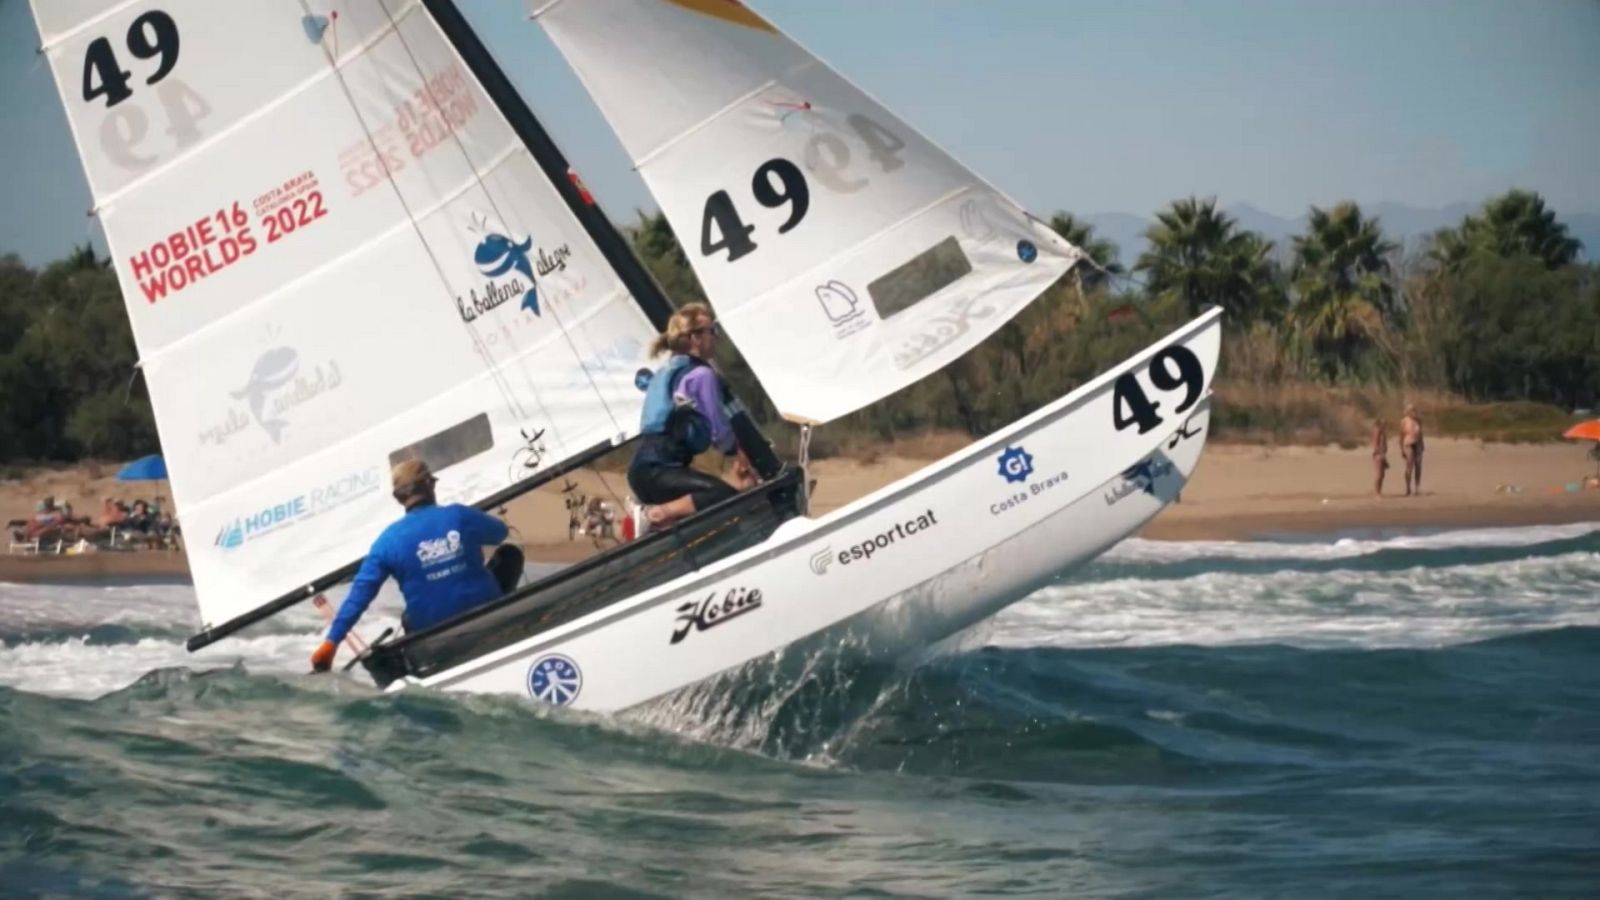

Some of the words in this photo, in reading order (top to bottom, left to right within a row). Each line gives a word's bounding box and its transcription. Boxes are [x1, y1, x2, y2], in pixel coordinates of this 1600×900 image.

[82, 10, 180, 108] 49
[130, 217, 217, 280] HOBIE
[215, 201, 249, 234] 16
[140, 228, 258, 304] WORLDS
[262, 191, 328, 243] 2022
[701, 158, 810, 262] 49
[1113, 345, 1204, 434] 49
[245, 495, 306, 534] HOBIE
[309, 465, 381, 508] RACING
[990, 492, 1029, 515] Costa
[1029, 471, 1069, 495] Brava
[837, 508, 938, 566] esportcat
[669, 586, 763, 645] Hobie
